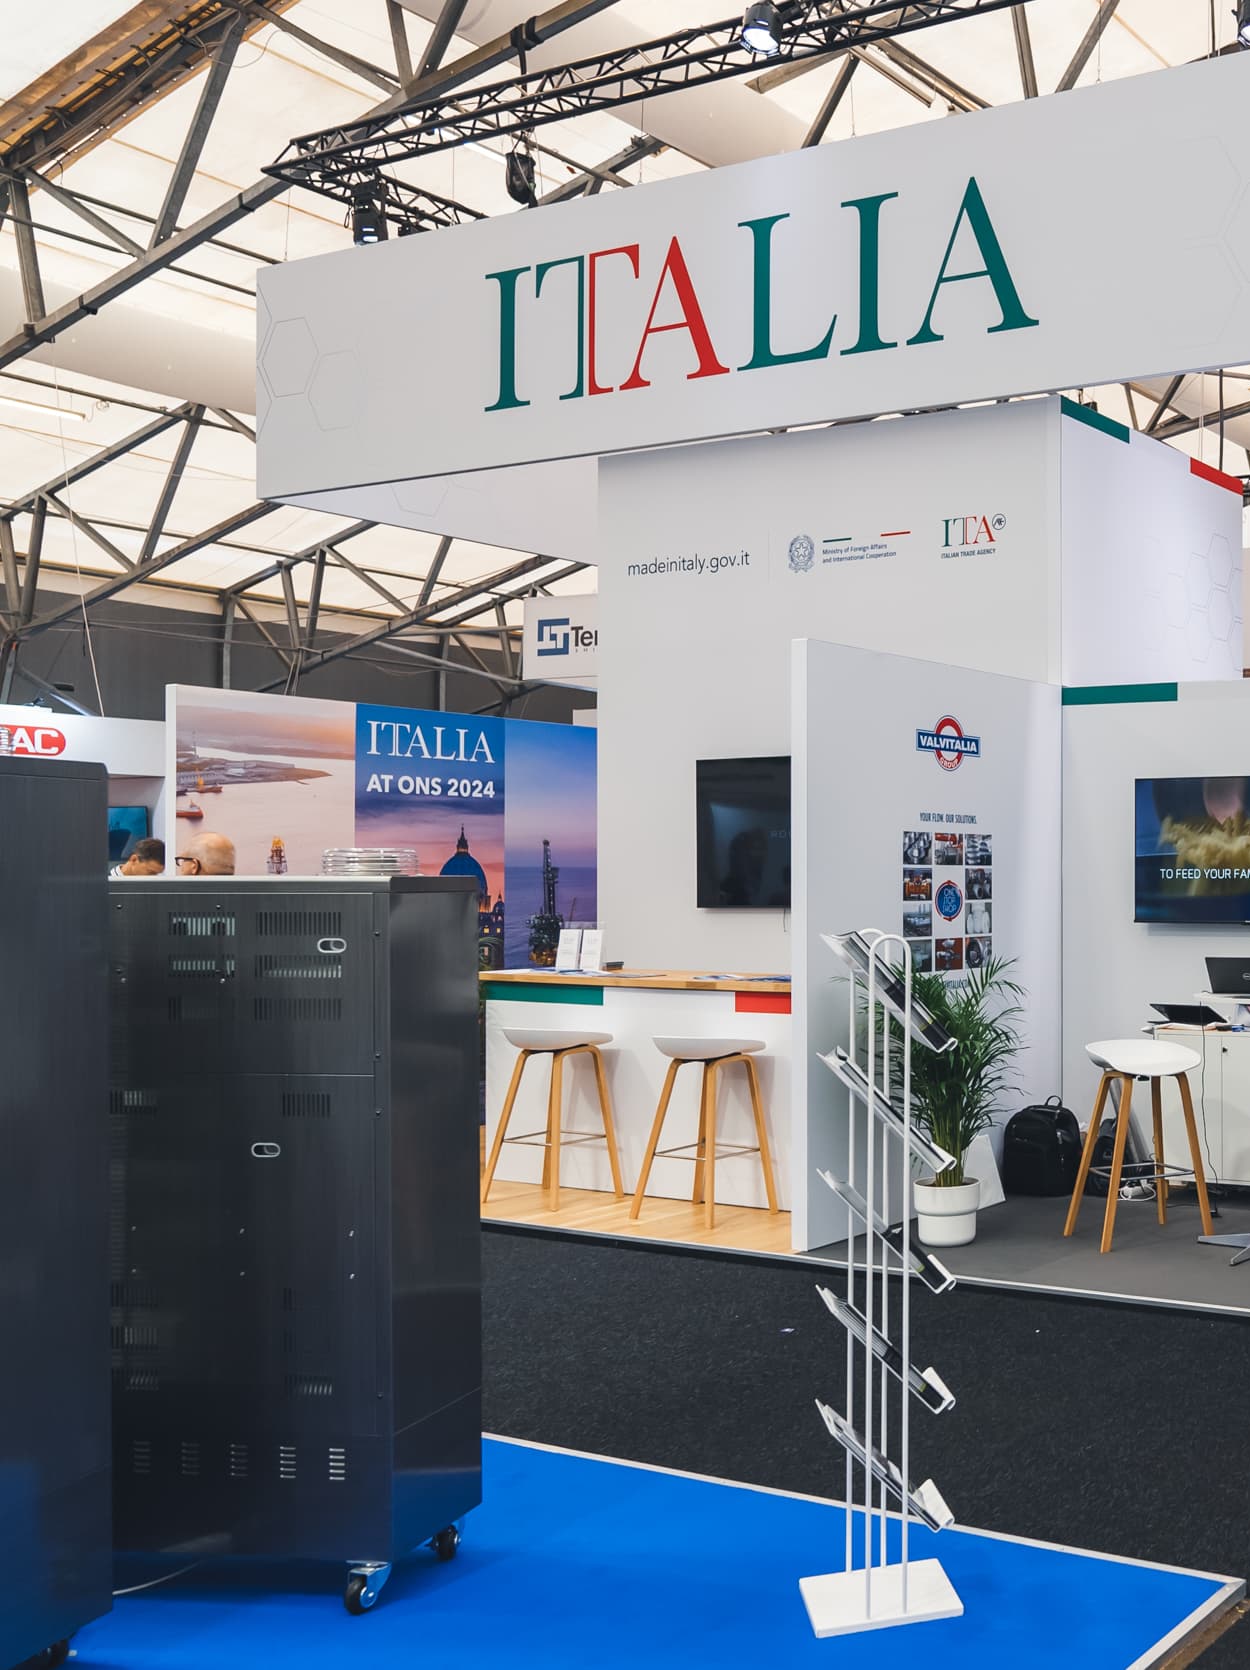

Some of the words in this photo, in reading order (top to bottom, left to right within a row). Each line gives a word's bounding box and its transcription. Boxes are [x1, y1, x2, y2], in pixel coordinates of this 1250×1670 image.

[485, 176, 1040, 412] ITALIA
[941, 515, 996, 548] ITA
[822, 547, 843, 555] Ministry
[850, 545, 870, 553] Foreign
[833, 554, 865, 563] International
[866, 551, 897, 560] Cooperation
[940, 551, 960, 559] ITALIAN
[960, 549, 976, 557] TRADE
[976, 547, 996, 556] AGENCY
[628, 550, 750, 576] madeinitaly.gov.it
[366, 720, 496, 763] ITALIA
[920, 734, 978, 753] VALVITALIA
[366, 773, 393, 793] AT
[398, 775, 442, 796] ONS
[447, 778, 496, 798] 2024
[1160, 868, 1173, 879] TO
[1175, 868, 1201, 879] FEED
[1203, 868, 1231, 879] YOUR
